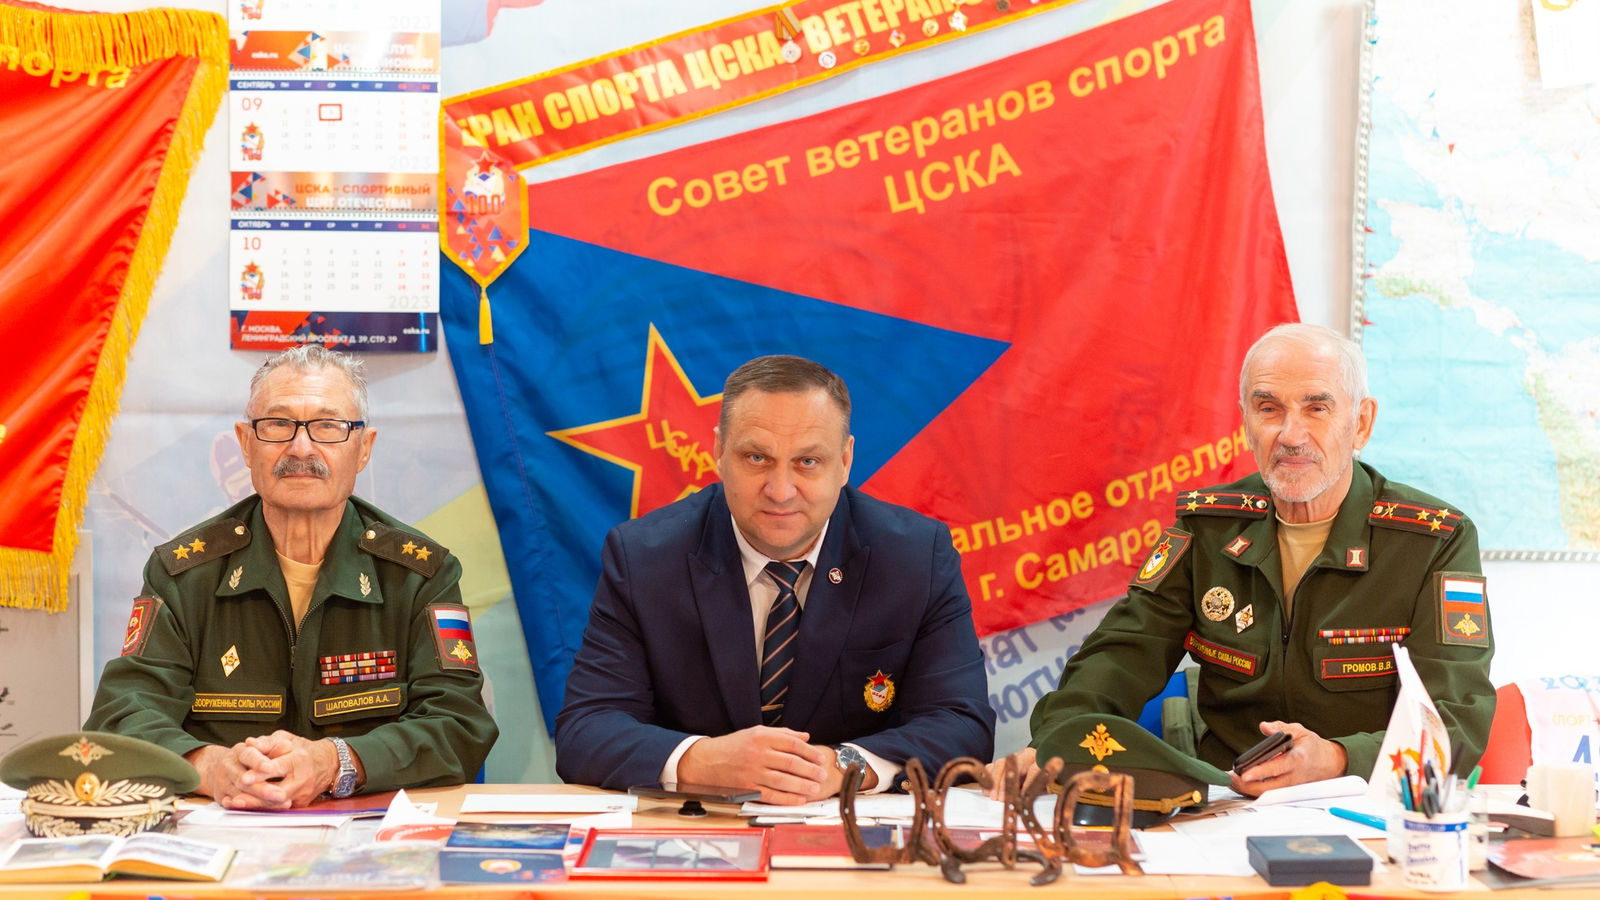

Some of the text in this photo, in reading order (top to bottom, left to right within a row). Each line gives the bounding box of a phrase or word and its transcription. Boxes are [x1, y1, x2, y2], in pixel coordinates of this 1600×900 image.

[0, 43, 131, 88] порта
[236, 81, 275, 90] СЕНТЯБРЬ
[543, 60, 688, 130] СПОРТА
[684, 30, 784, 90] ЦСКА
[241, 97, 262, 111] 09
[647, 14, 1227, 216] Совет ветеранов спорта
[883, 142, 1023, 214] ЦСКА
[295, 183, 330, 195] ЦСКА
[342, 182, 431, 195] СПОРТИВНЫЙ
[238, 220, 271, 229] ОКТЯБРЬ
[243, 237, 262, 250] 10
[389, 295, 431, 309] 2023
[645, 419, 722, 480] ЦСКА
[951, 424, 1249, 556] альное отделен
[979, 519, 1162, 601] г. Самара
[1342, 660, 1393, 674] ГРОМОВ В.В.
[238, 699, 256, 709] СИЛЫ
[256, 699, 281, 710] РОССИИ
[325, 694, 390, 711] ШАПОВАЛОВ А.А.
